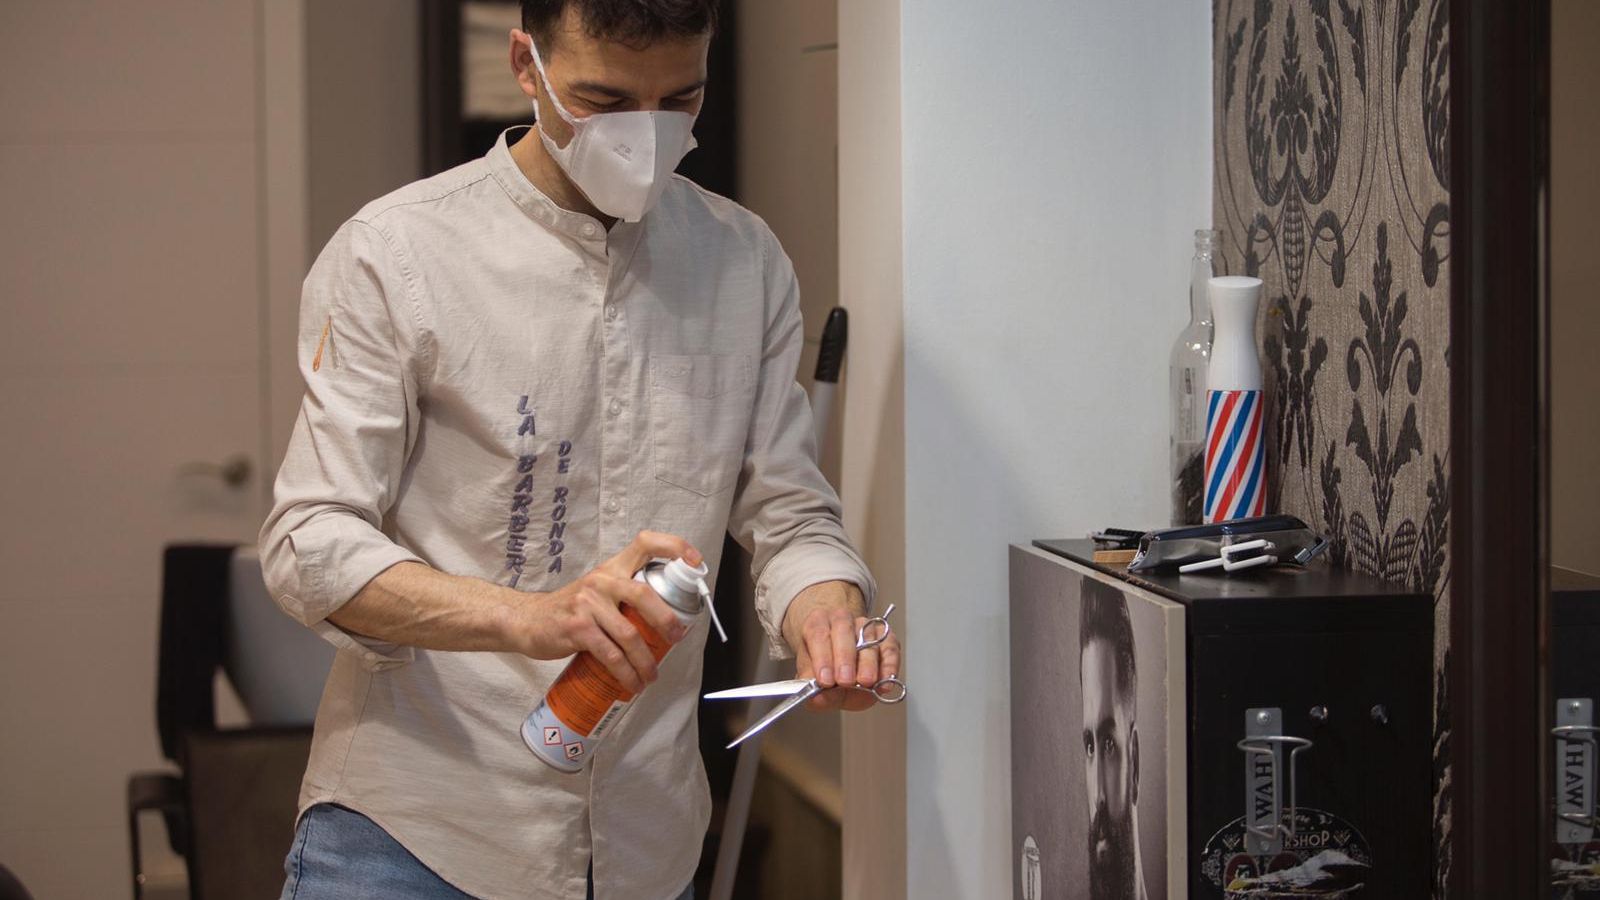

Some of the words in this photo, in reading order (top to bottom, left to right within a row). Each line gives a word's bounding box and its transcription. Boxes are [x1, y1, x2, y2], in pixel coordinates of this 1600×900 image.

[517, 395, 536, 436] LA
[557, 440, 572, 474] DE
[548, 486, 569, 574] RONDA
